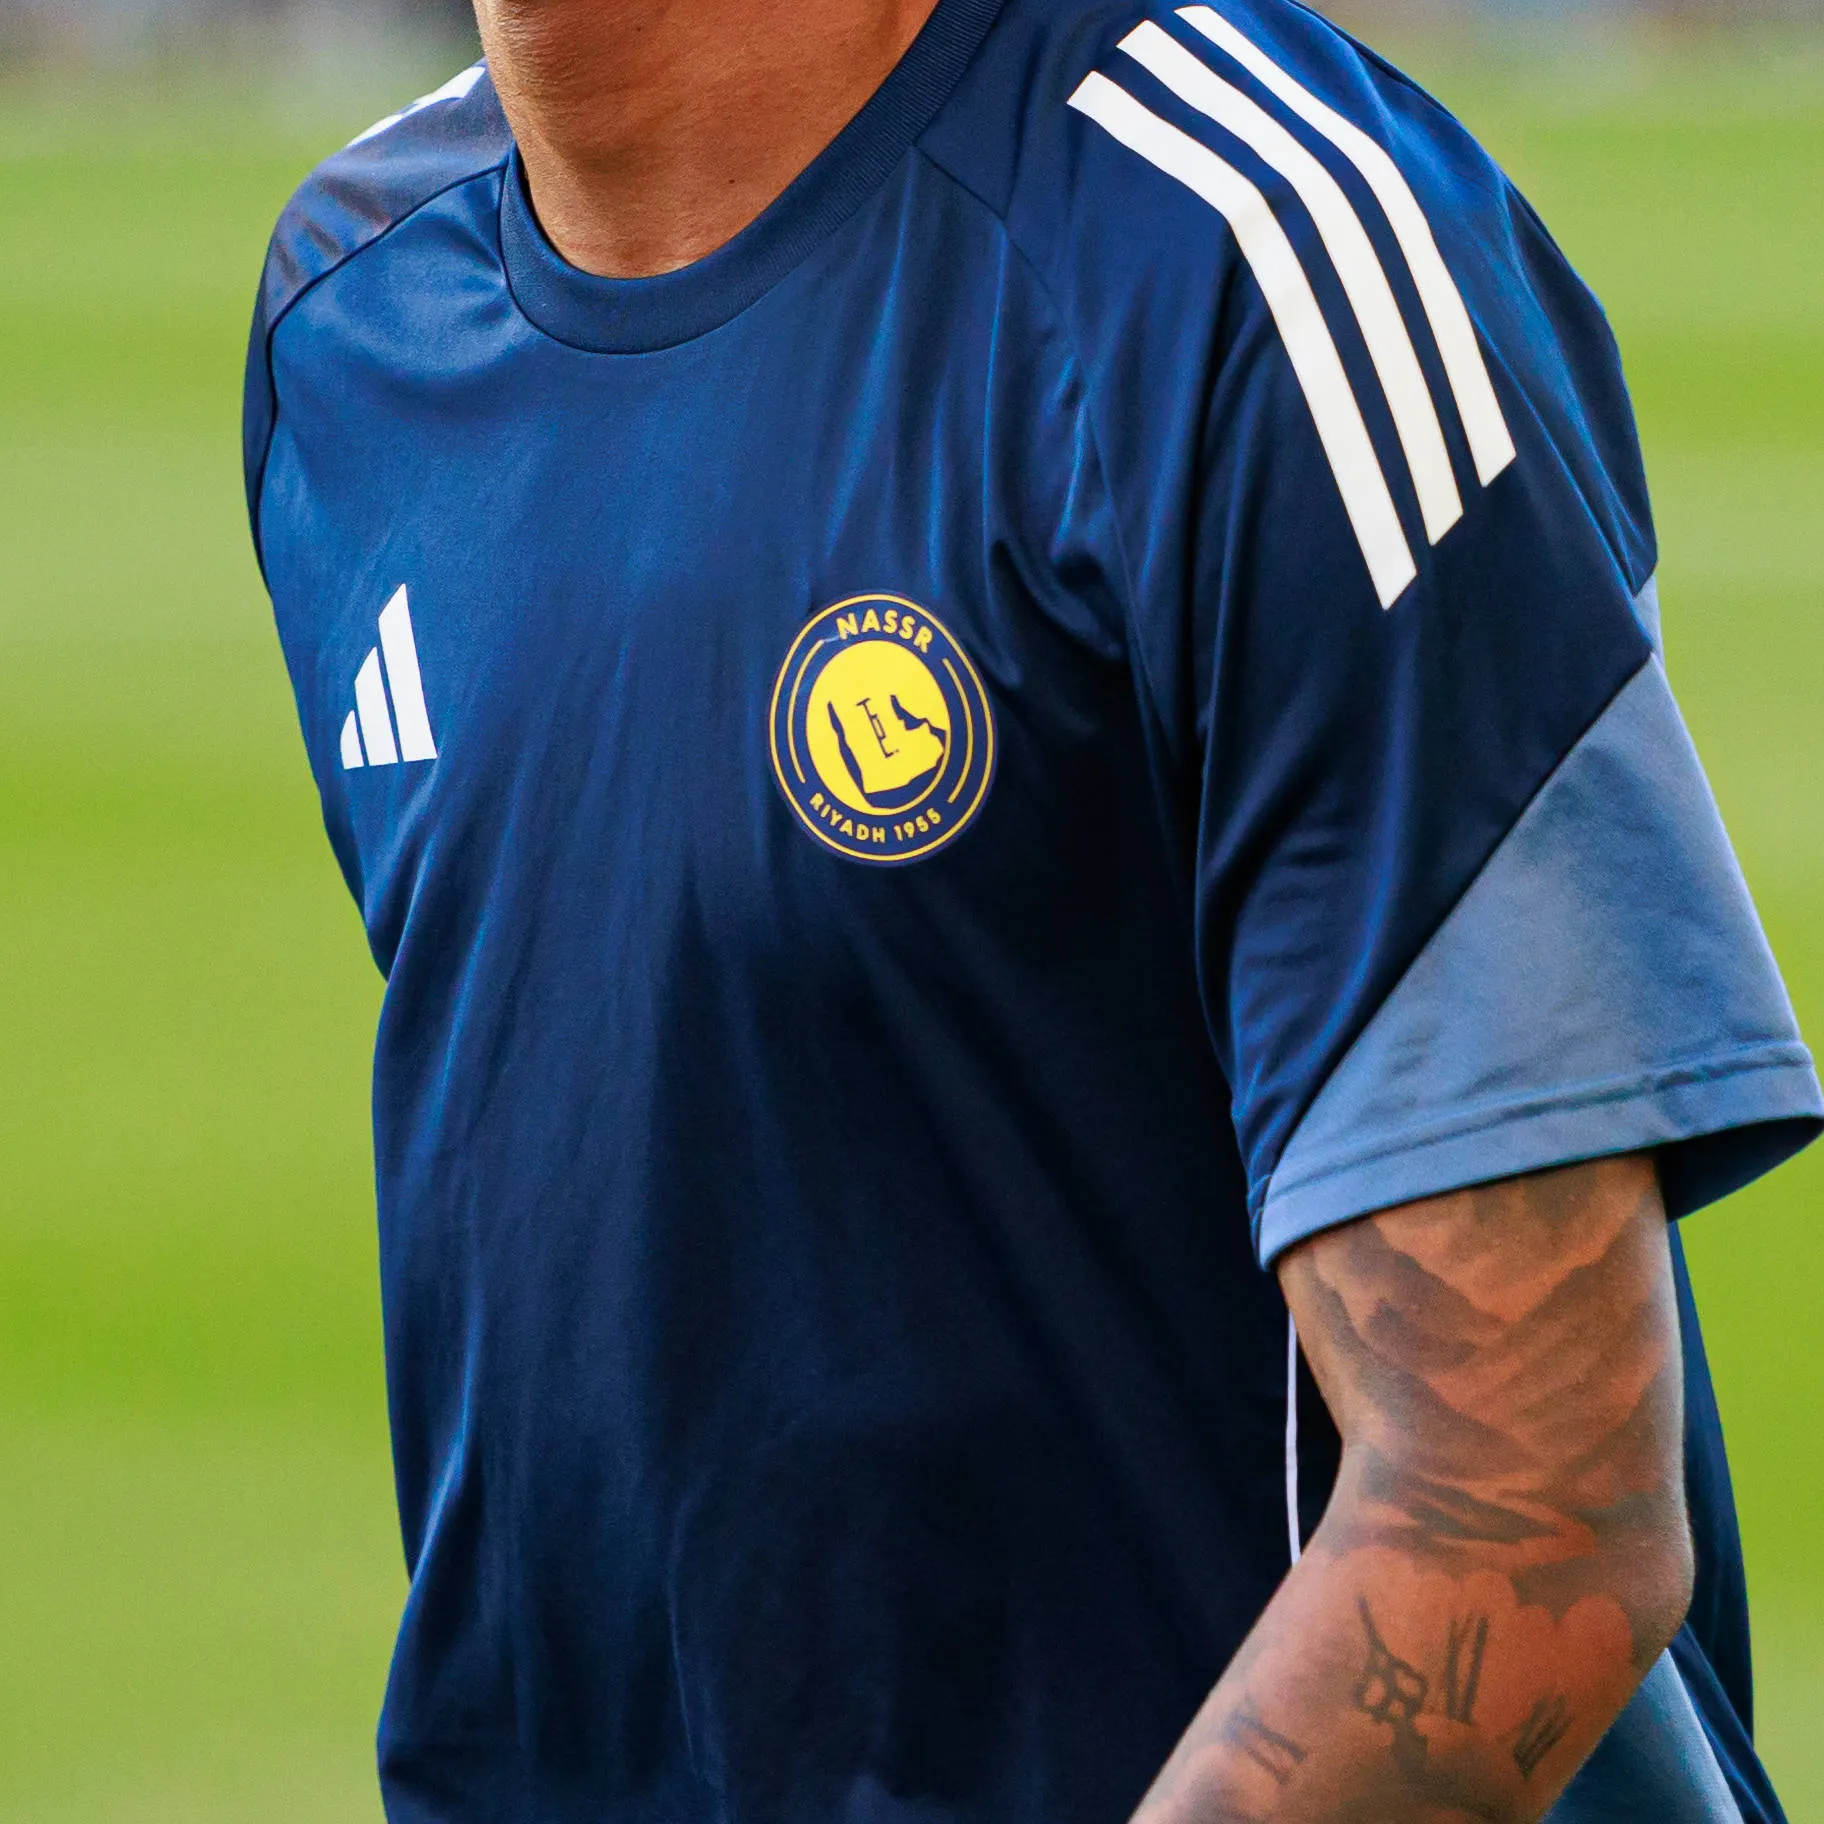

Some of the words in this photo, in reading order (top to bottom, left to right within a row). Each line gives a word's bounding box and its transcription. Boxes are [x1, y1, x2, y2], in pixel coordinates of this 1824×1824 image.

[836, 609, 933, 653] NASSR
[809, 792, 886, 844] RIYADH
[893, 808, 942, 842] 1955
